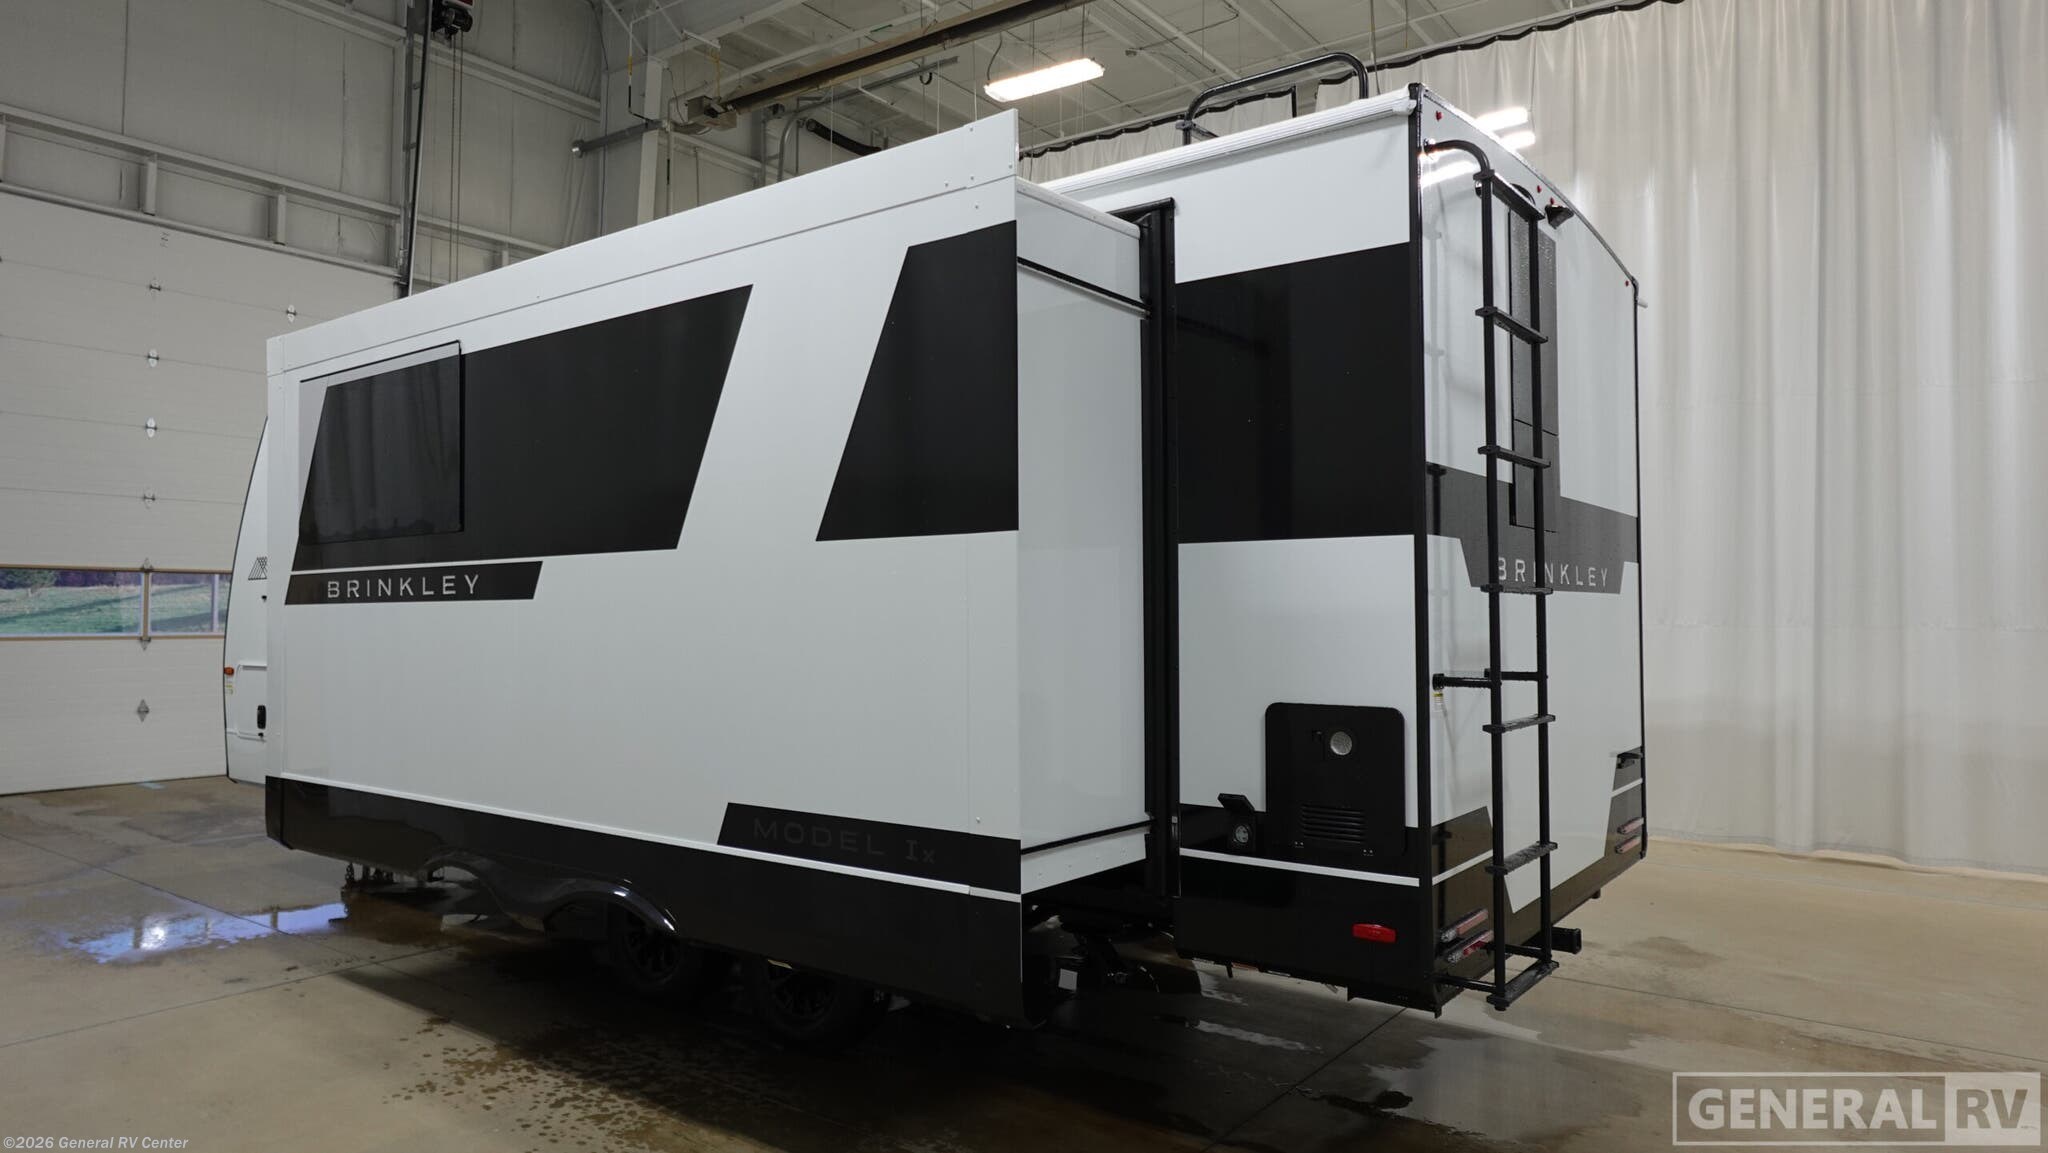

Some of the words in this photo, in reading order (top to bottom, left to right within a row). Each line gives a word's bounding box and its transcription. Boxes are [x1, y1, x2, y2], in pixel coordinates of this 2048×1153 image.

[327, 574, 479, 598] BRINKLEY
[1498, 557, 1608, 586] BRINKLEY
[753, 817, 886, 856] MODEL
